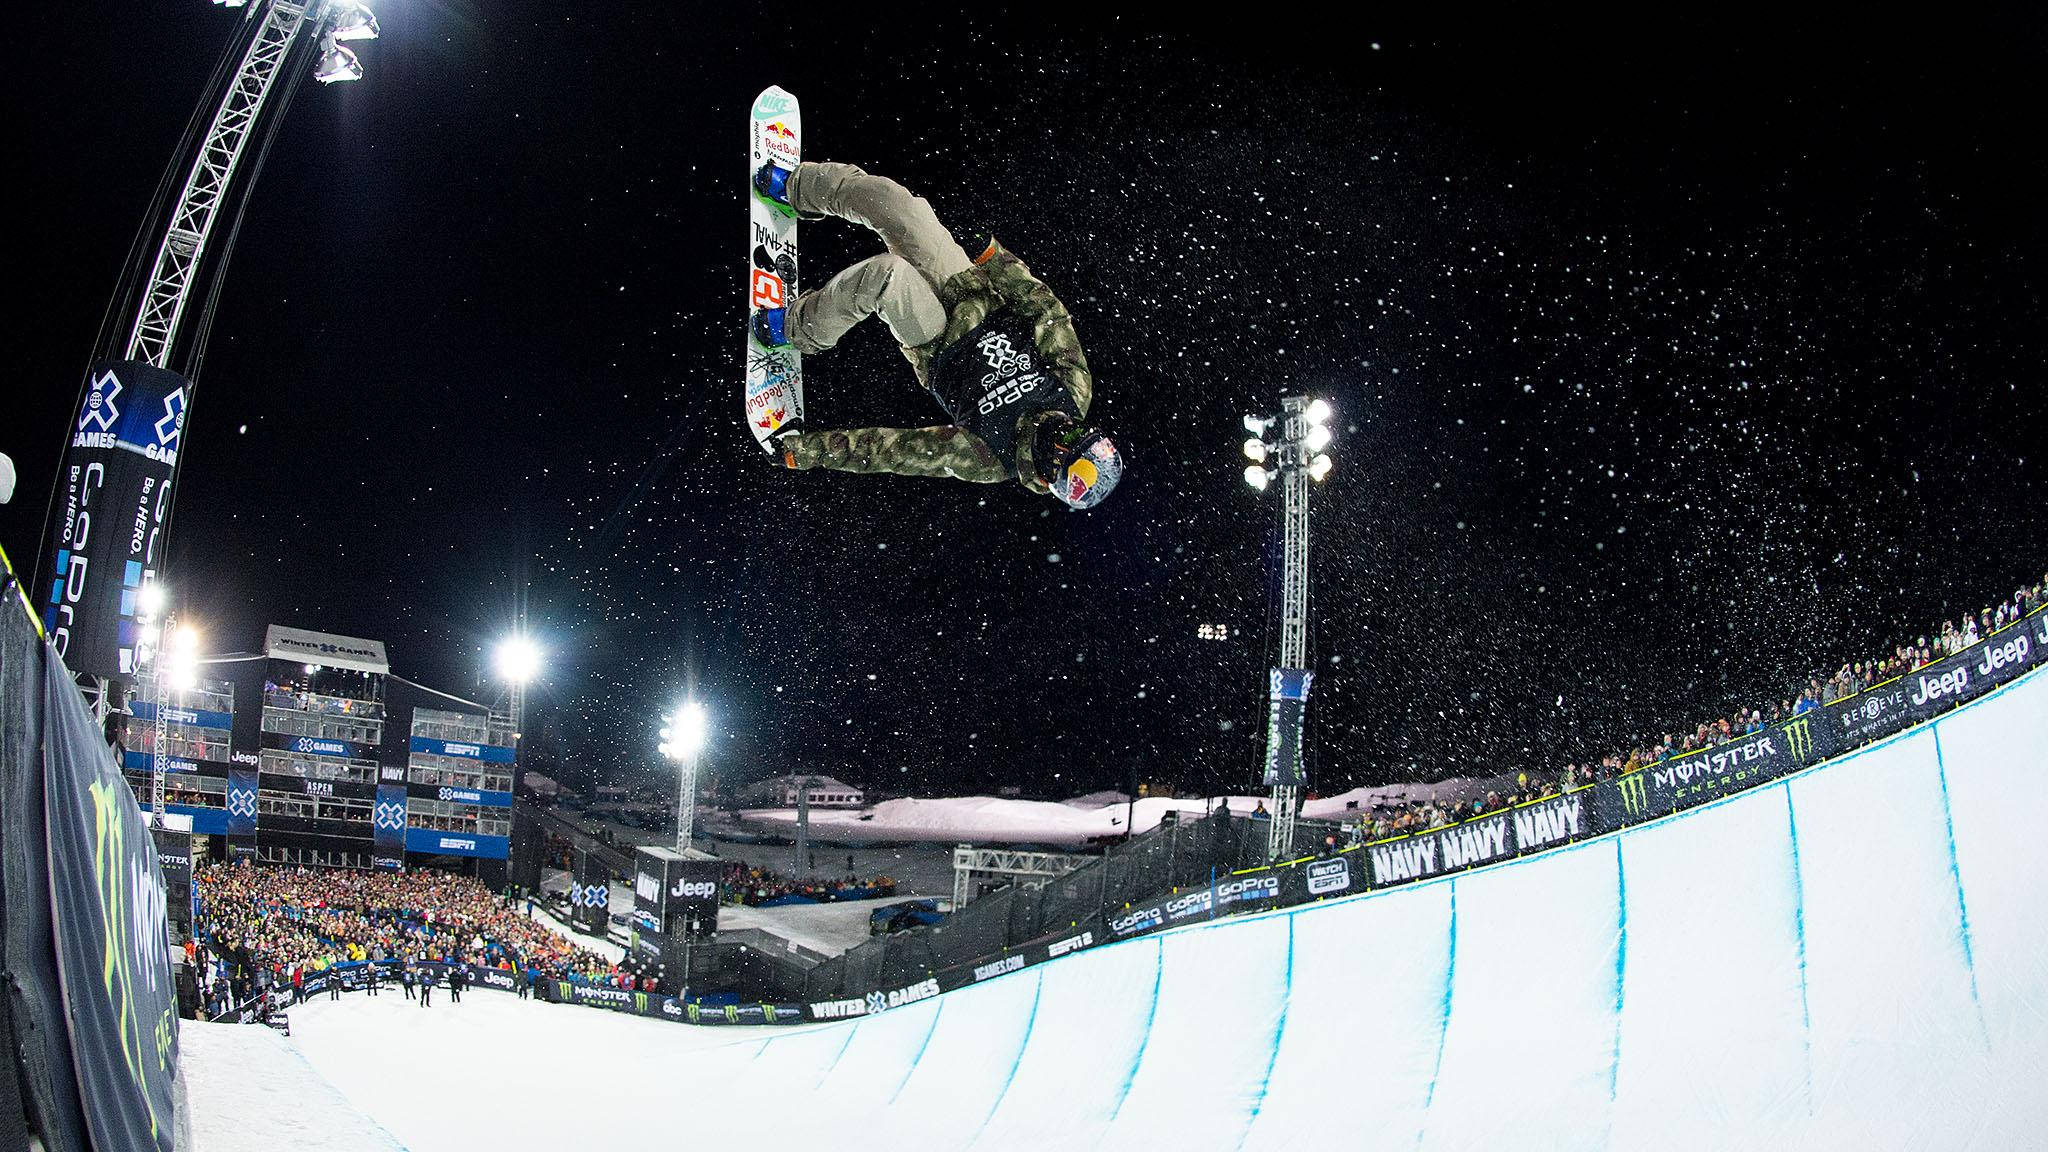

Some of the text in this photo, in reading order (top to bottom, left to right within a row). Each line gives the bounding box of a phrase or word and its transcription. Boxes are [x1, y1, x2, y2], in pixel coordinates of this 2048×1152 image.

[760, 94, 788, 112] NIKE
[765, 138, 801, 157] Red Bull
[762, 385, 783, 406] Red
[70, 465, 80, 482] Be
[142, 477, 155, 494] Be
[280, 638, 318, 648] WINTER
[338, 647, 376, 657] GAMES
[1978, 635, 2029, 675] Jeep
[1911, 666, 1968, 705] Jeep
[1843, 691, 1903, 726] REPREVE
[314, 743, 343, 753] GAMES
[170, 761, 198, 771] GAMES
[231, 751, 258, 766] Jeep
[1654, 736, 1776, 788] MONSTER
[382, 767, 404, 780] NAVY
[1675, 765, 1761, 798] ENERGY
[307, 782, 333, 793] ASPEN
[453, 791, 480, 801] GAMES
[1515, 802, 1580, 849] NAVY
[1442, 821, 1506, 868] NAVY
[1311, 864, 1342, 877] WATCH
[1372, 840, 1436, 883] NAVY
[671, 879, 716, 898] Jeep
[1218, 877, 1278, 896] GoPro
[1166, 890, 1212, 913] GoPro
[1112, 908, 1161, 931] GoPro
[484, 972, 514, 988] Jeep
[574, 986, 632, 1002] MONSTER
[810, 999, 866, 1018] WINTER
[888, 978, 940, 1007] GAMES
[663, 1000, 682, 1016] abc
